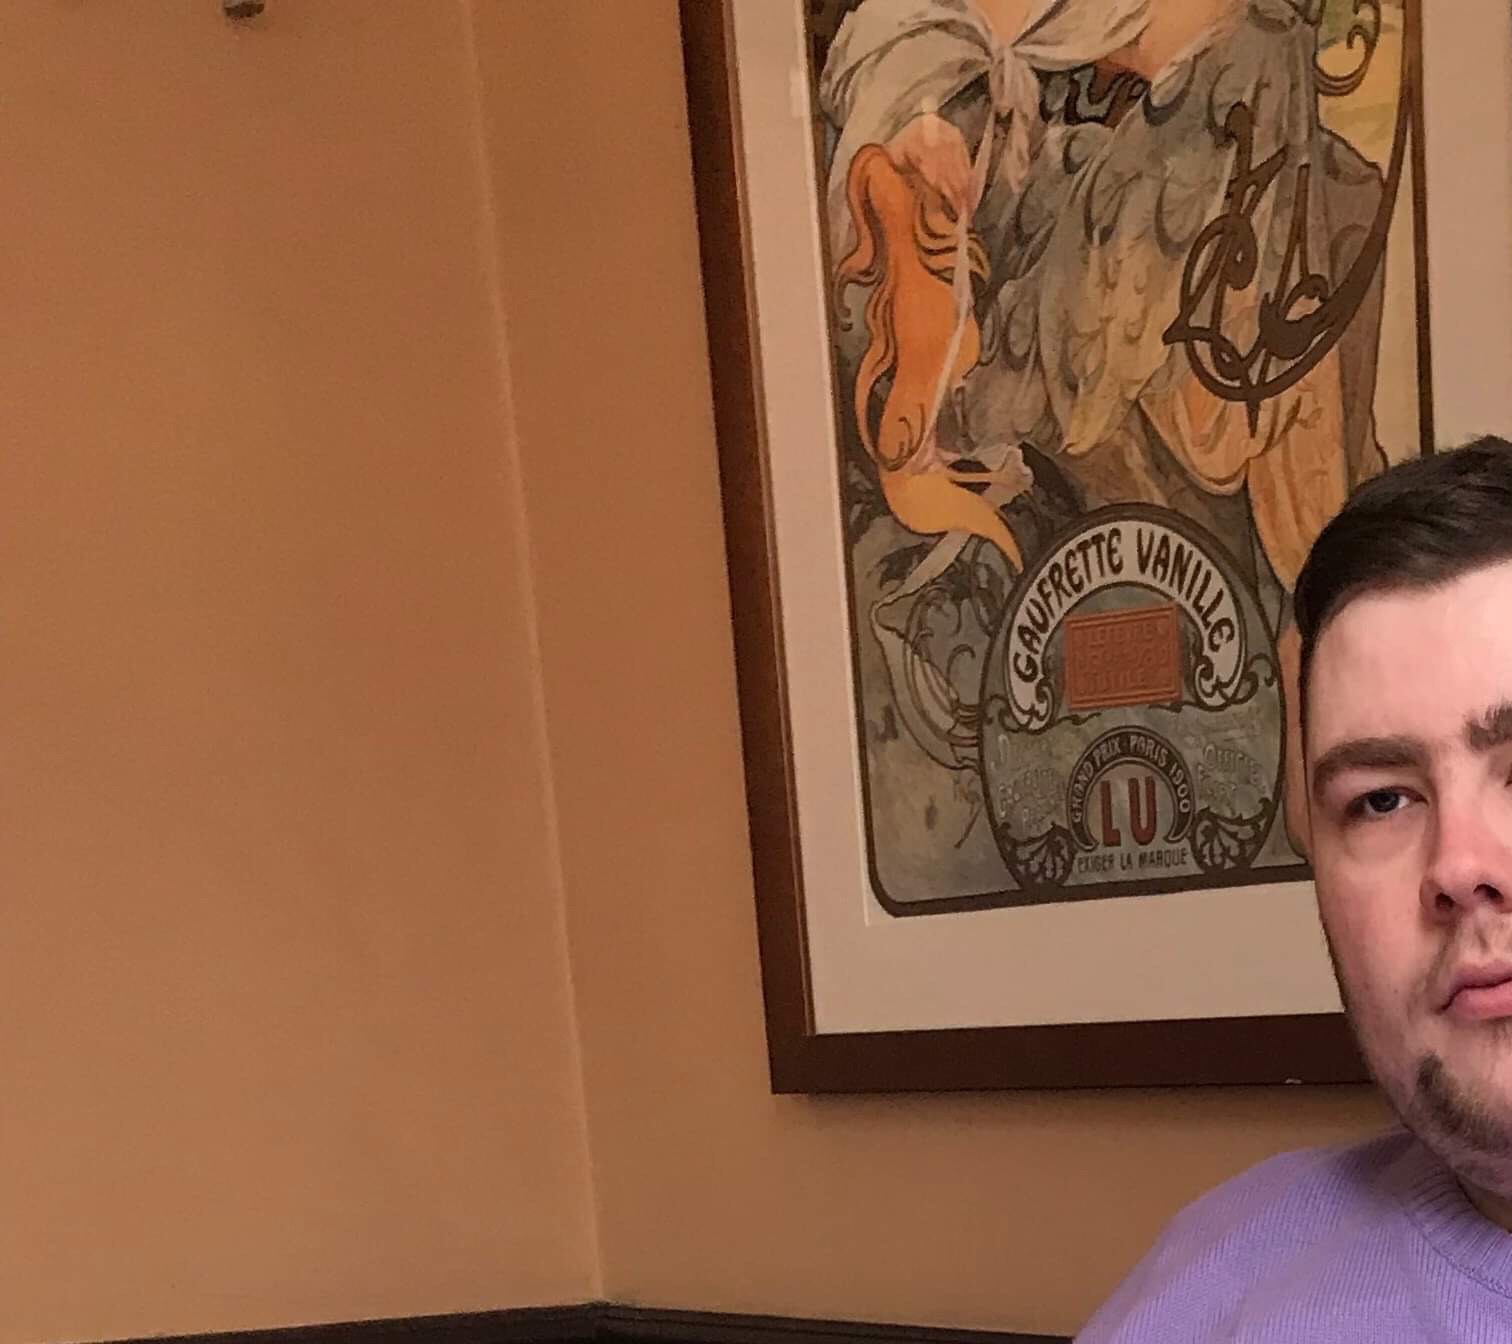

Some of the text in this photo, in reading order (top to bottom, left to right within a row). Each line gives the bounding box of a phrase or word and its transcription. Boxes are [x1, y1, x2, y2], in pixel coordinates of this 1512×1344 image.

[1013, 526, 1236, 683] GAUFRETTE VANILLE
[1092, 737, 1122, 766] PRIX
[1129, 734, 1169, 769] PARIS
[1168, 763, 1191, 814] 1900
[1101, 775, 1158, 848] LU
[1138, 847, 1188, 870] MARQUE
